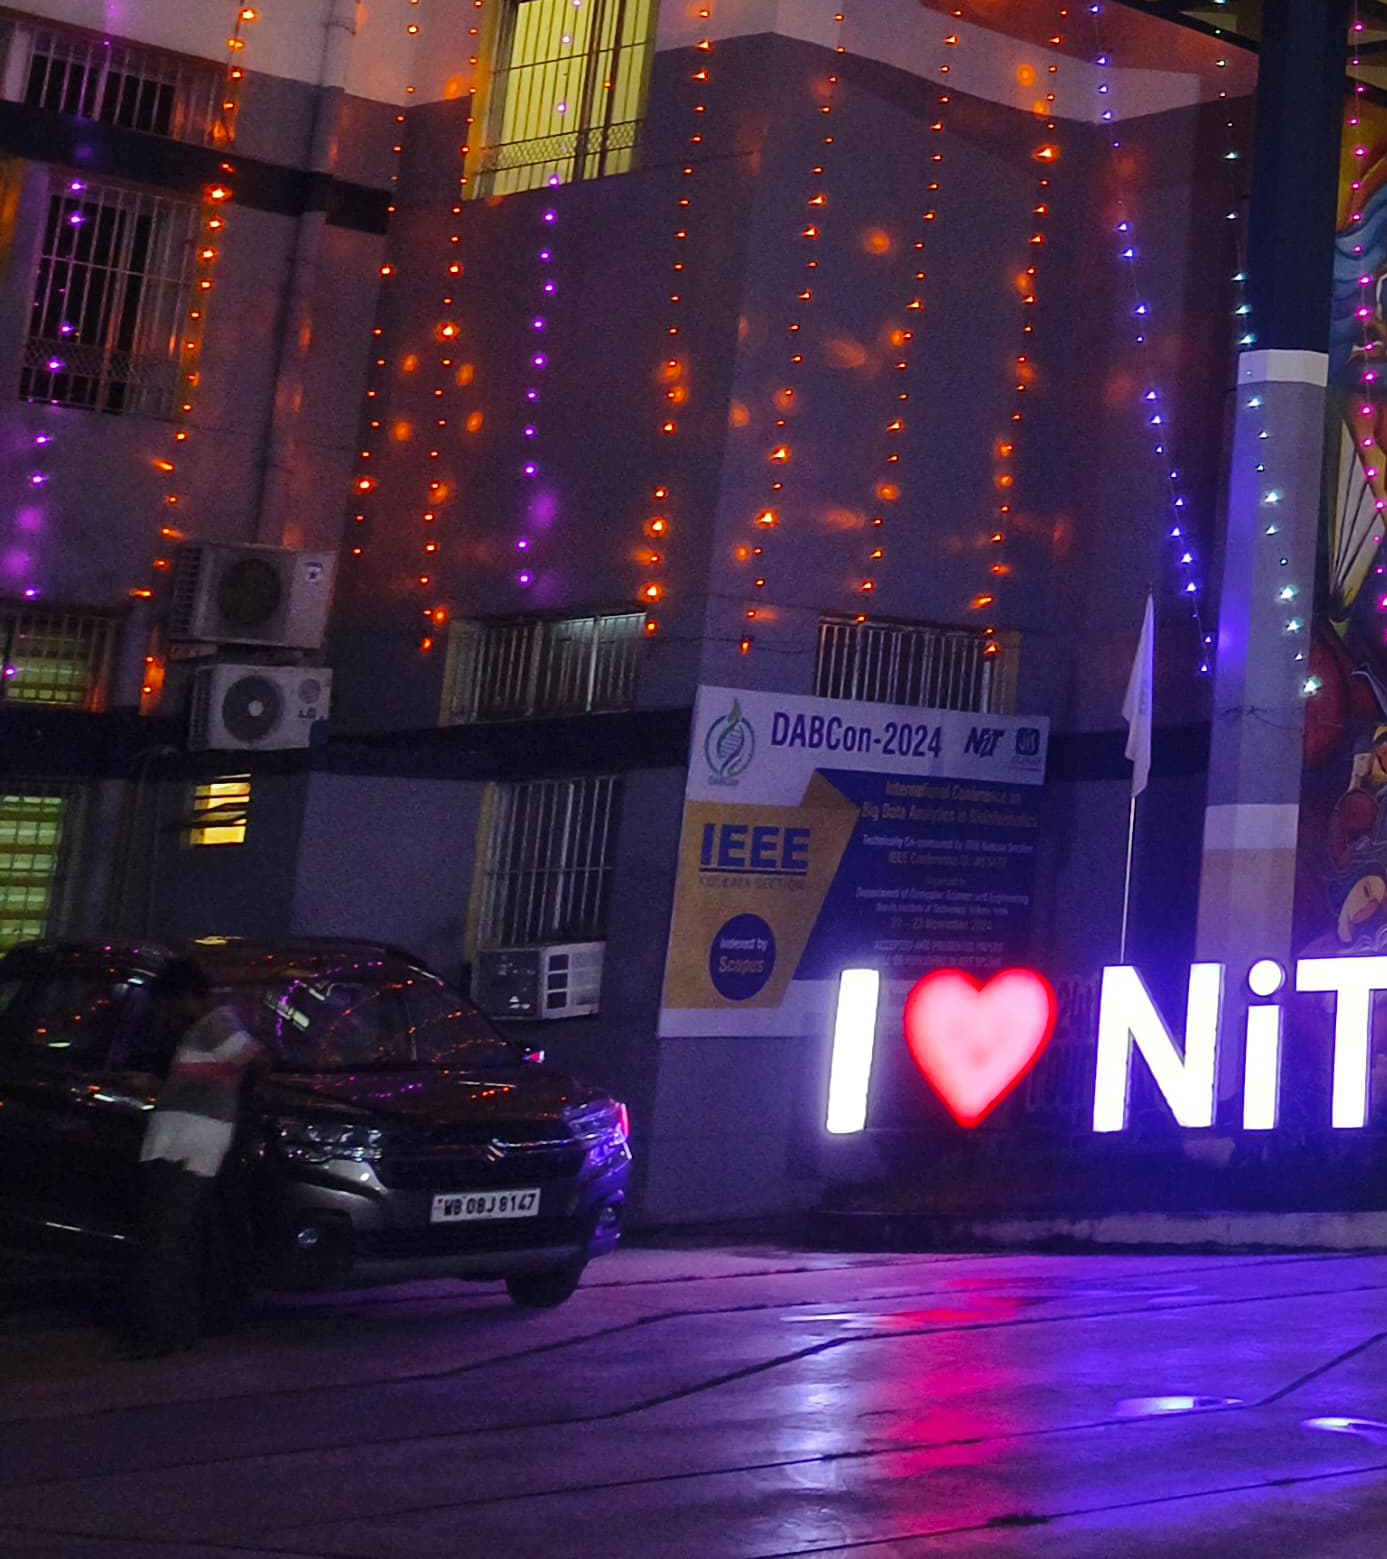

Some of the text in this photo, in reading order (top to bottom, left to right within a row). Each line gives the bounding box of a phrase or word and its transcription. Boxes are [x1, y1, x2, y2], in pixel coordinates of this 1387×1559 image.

[771, 712, 942, 758] DABCon-2024
[861, 801, 880, 822] Big
[882, 802, 906, 820] Data
[701, 823, 811, 869] IEEE
[719, 955, 764, 976] Scopus
[443, 1199, 463, 1217] WB
[499, 1192, 537, 1213] 8147
